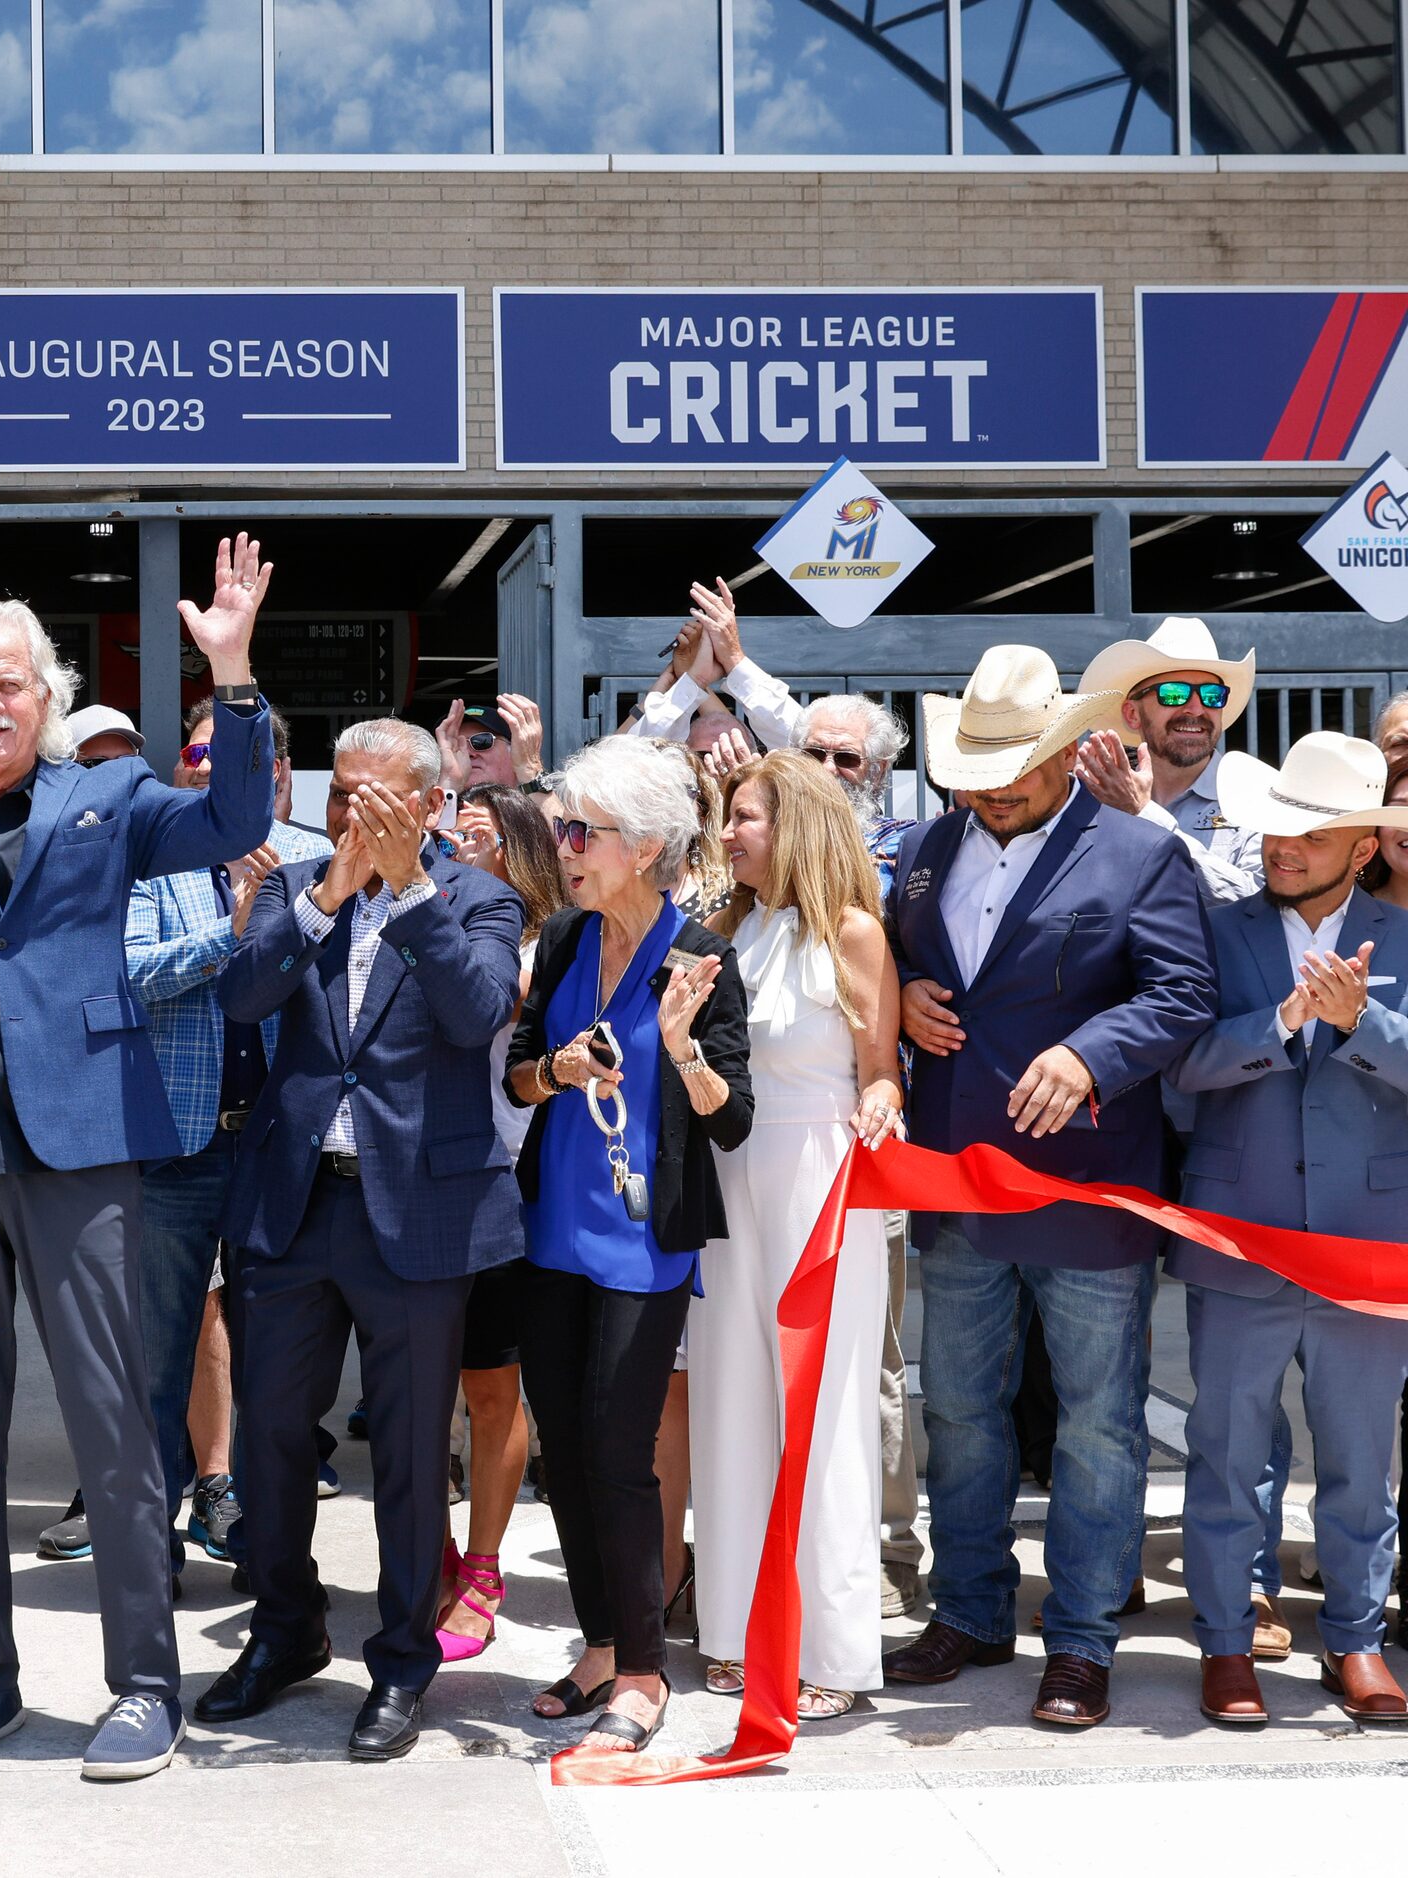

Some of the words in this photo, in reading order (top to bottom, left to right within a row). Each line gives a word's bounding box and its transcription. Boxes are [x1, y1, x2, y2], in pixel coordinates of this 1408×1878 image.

[640, 316, 783, 347] MAJOR
[800, 316, 956, 347] LEAGUE
[208, 339, 389, 378] SEASON
[106, 398, 205, 432] 2023
[610, 360, 988, 443] CRICKET
[825, 517, 881, 559] MI
[1347, 537, 1369, 546] SAN
[806, 565, 841, 577] NEW
[844, 565, 882, 577] YORK
[1338, 547, 1408, 567] UNICO
